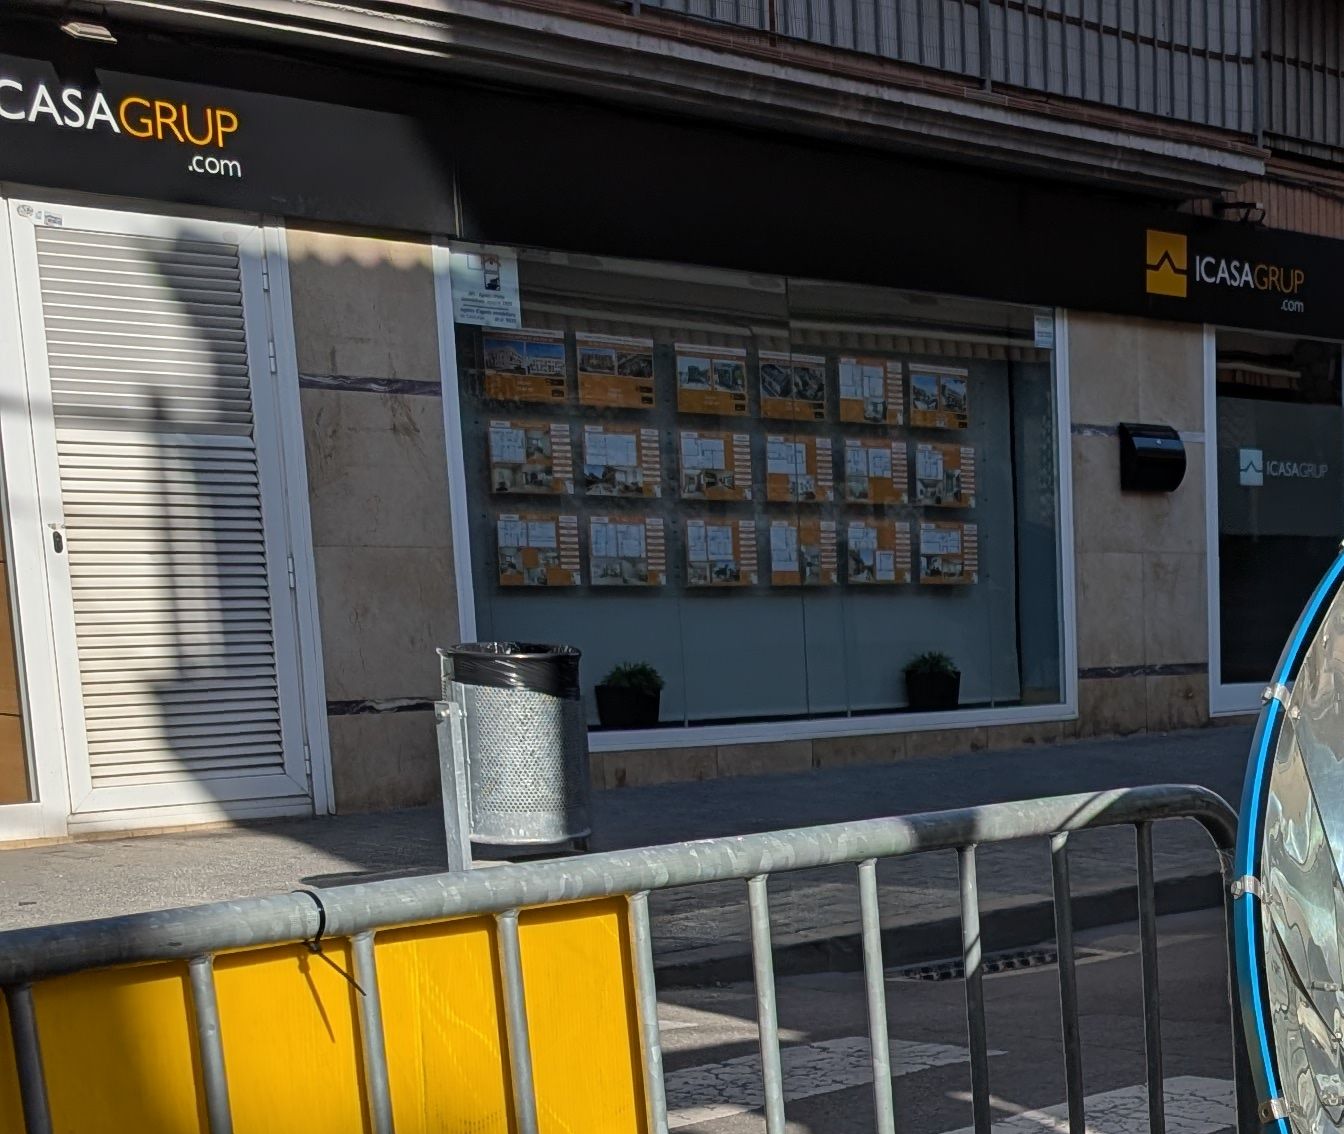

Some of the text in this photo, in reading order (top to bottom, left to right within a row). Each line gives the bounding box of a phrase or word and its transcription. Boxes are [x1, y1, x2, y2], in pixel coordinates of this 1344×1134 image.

[188, 155, 241, 177] .com
[1196, 256, 1305, 294] ICASAGRUP
[1281, 299, 1305, 313] .com
[1266, 460, 1328, 479] ICASAGRUP
